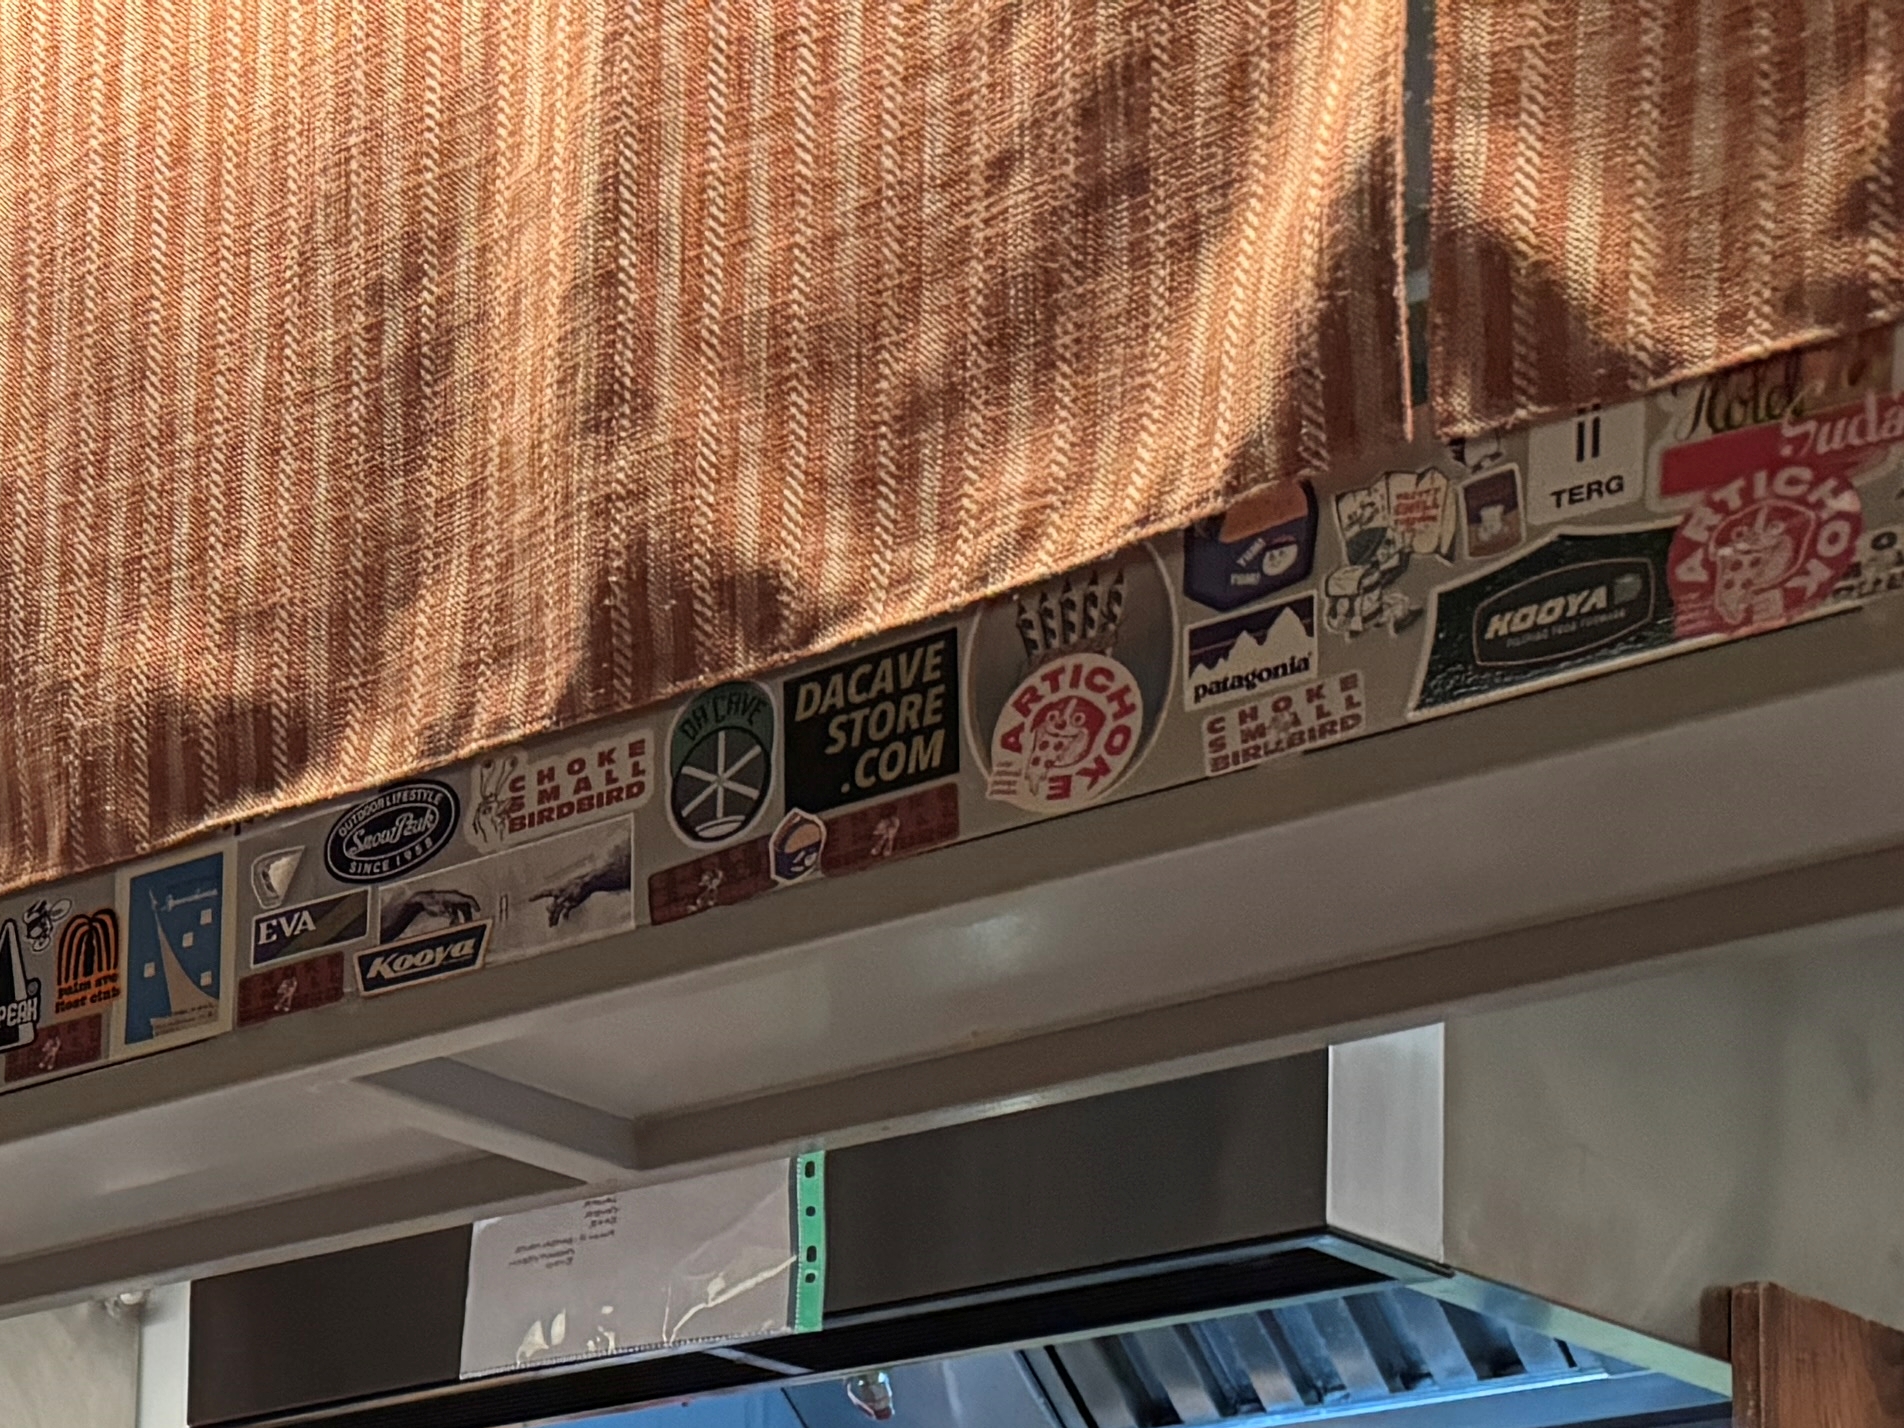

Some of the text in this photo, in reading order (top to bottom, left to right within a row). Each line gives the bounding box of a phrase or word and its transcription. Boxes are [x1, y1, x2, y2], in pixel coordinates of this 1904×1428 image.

[1550, 475, 1624, 508] TERG
[1485, 585, 1608, 640] KOOYA
[794, 640, 945, 721] DACAVE
[1194, 655, 1311, 703] patagonia
[825, 685, 945, 754] STORE
[1000, 664, 1136, 800] ARTICHOKE
[508, 739, 646, 793] CHOKE
[840, 730, 945, 793] .COM
[507, 780, 646, 834] BIRDBIRD
[349, 859, 389, 875] SINCE
[258, 910, 316, 945] EVA
[366, 939, 476, 980] Kooya
